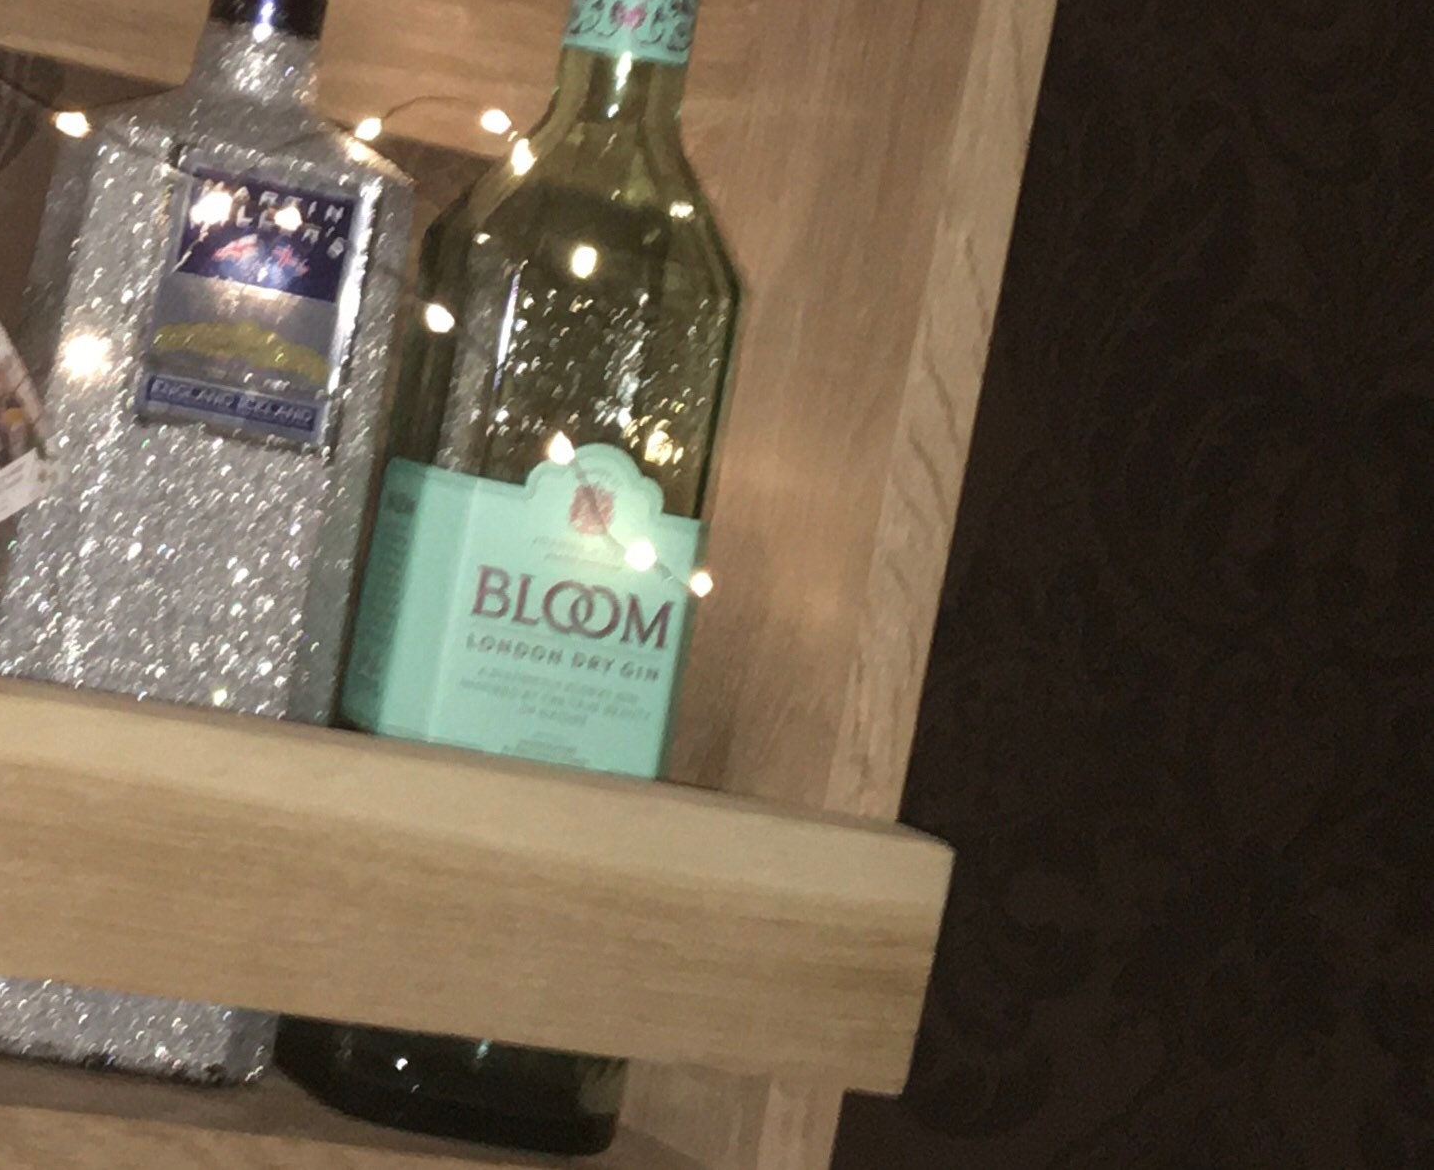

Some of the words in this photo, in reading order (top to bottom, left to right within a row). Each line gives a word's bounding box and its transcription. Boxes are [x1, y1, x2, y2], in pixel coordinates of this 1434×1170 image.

[470, 563, 676, 651] BLOOM
[466, 632, 563, 667] LONDON
[569, 647, 615, 675] DRY
[619, 659, 661, 683] GIN
